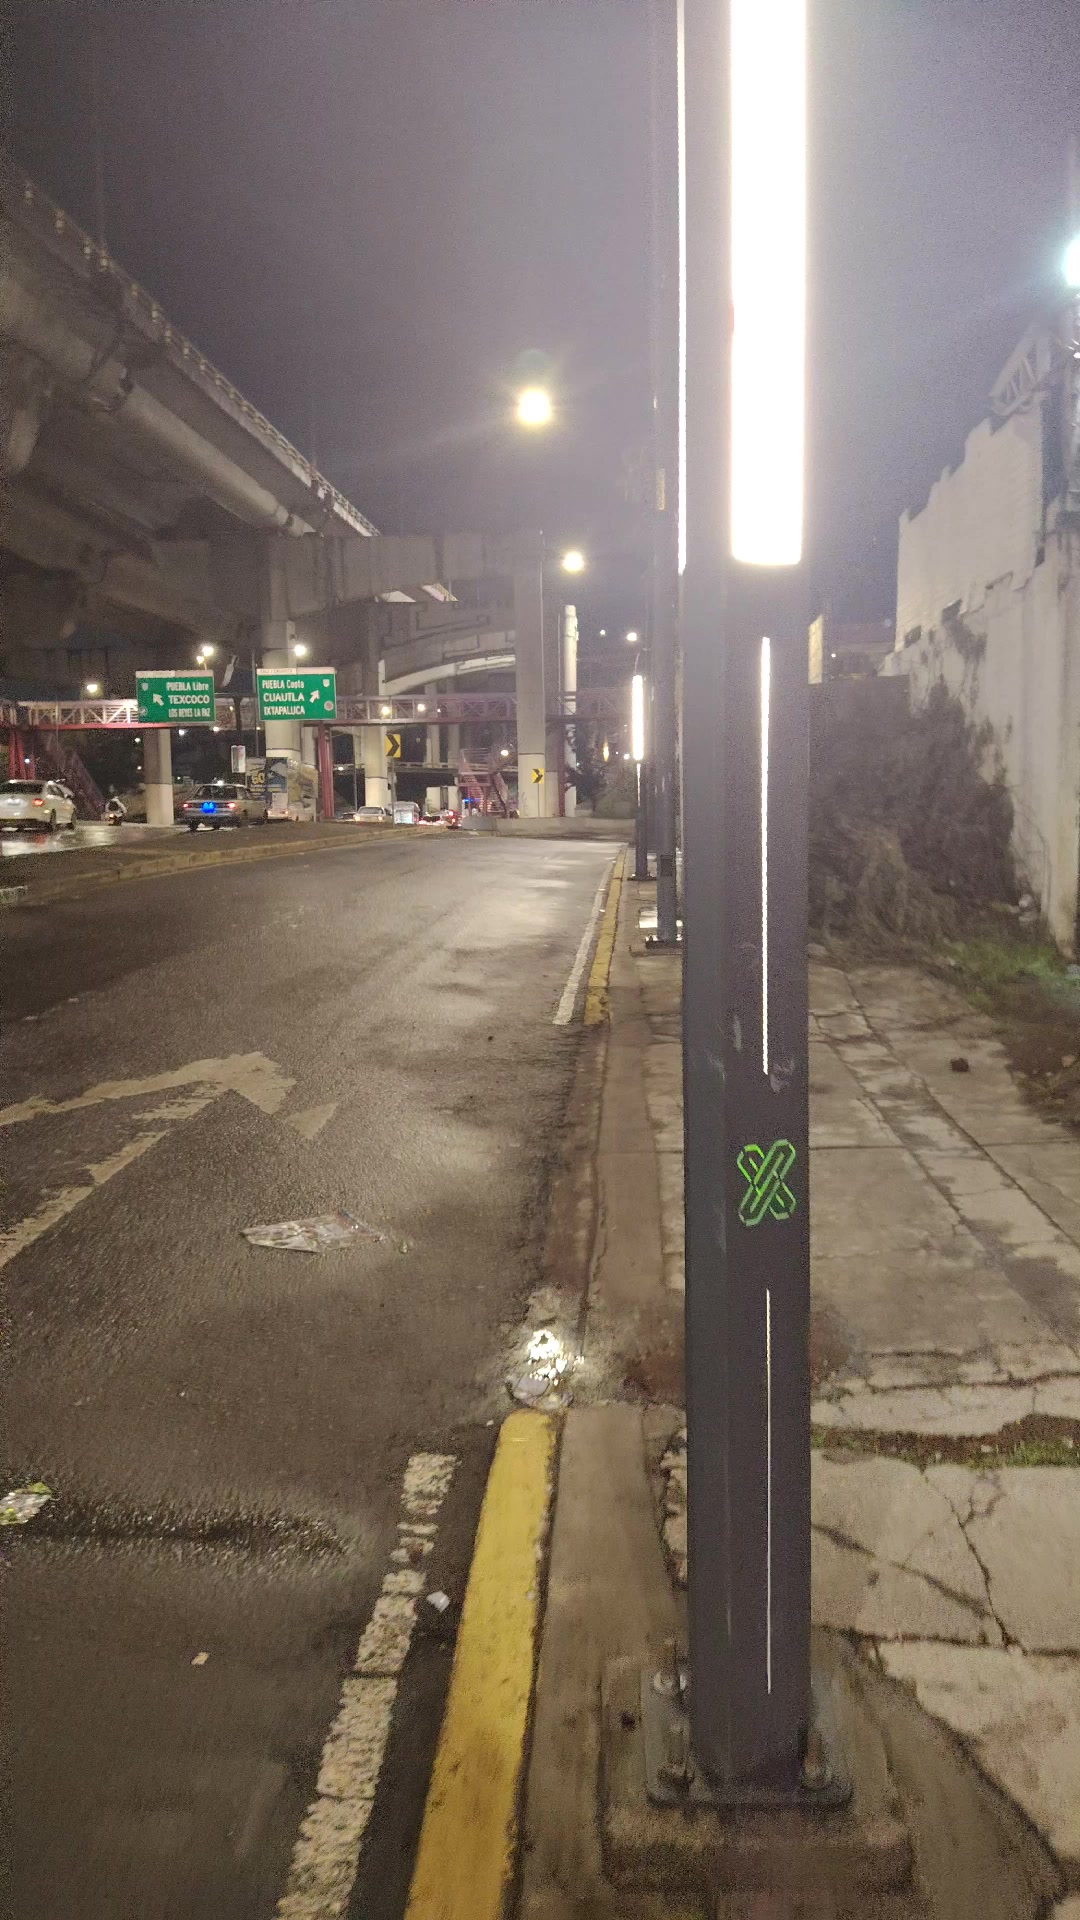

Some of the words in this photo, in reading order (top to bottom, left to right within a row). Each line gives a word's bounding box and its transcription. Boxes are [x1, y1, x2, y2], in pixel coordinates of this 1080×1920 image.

[166, 682, 191, 691] PUEBLA
[192, 681, 210, 691] Libre
[262, 680, 285, 689] PUEBLA
[168, 695, 210, 704] TEXCOCO
[263, 692, 305, 702] CUAUTLA
[264, 706, 306, 715] IXTAPALUCA
